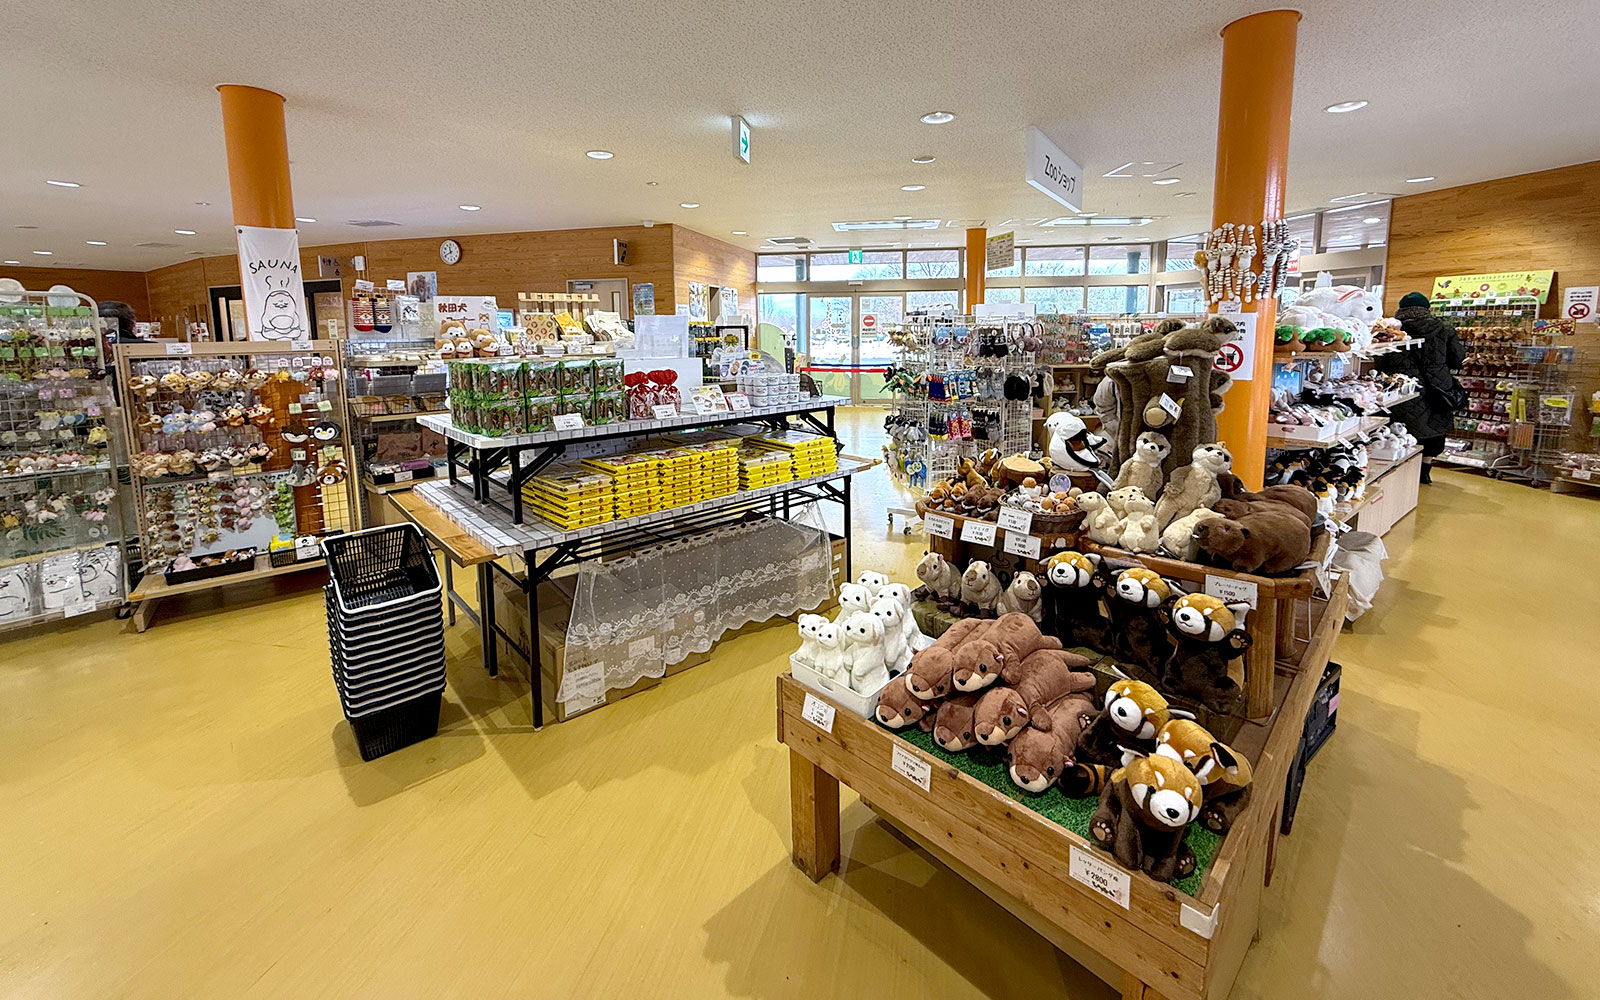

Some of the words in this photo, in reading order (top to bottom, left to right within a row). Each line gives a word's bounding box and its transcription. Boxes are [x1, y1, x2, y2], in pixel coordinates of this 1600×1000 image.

[249, 259, 298, 274] SAUNA
[438, 303, 467, 313] 秋田犬
